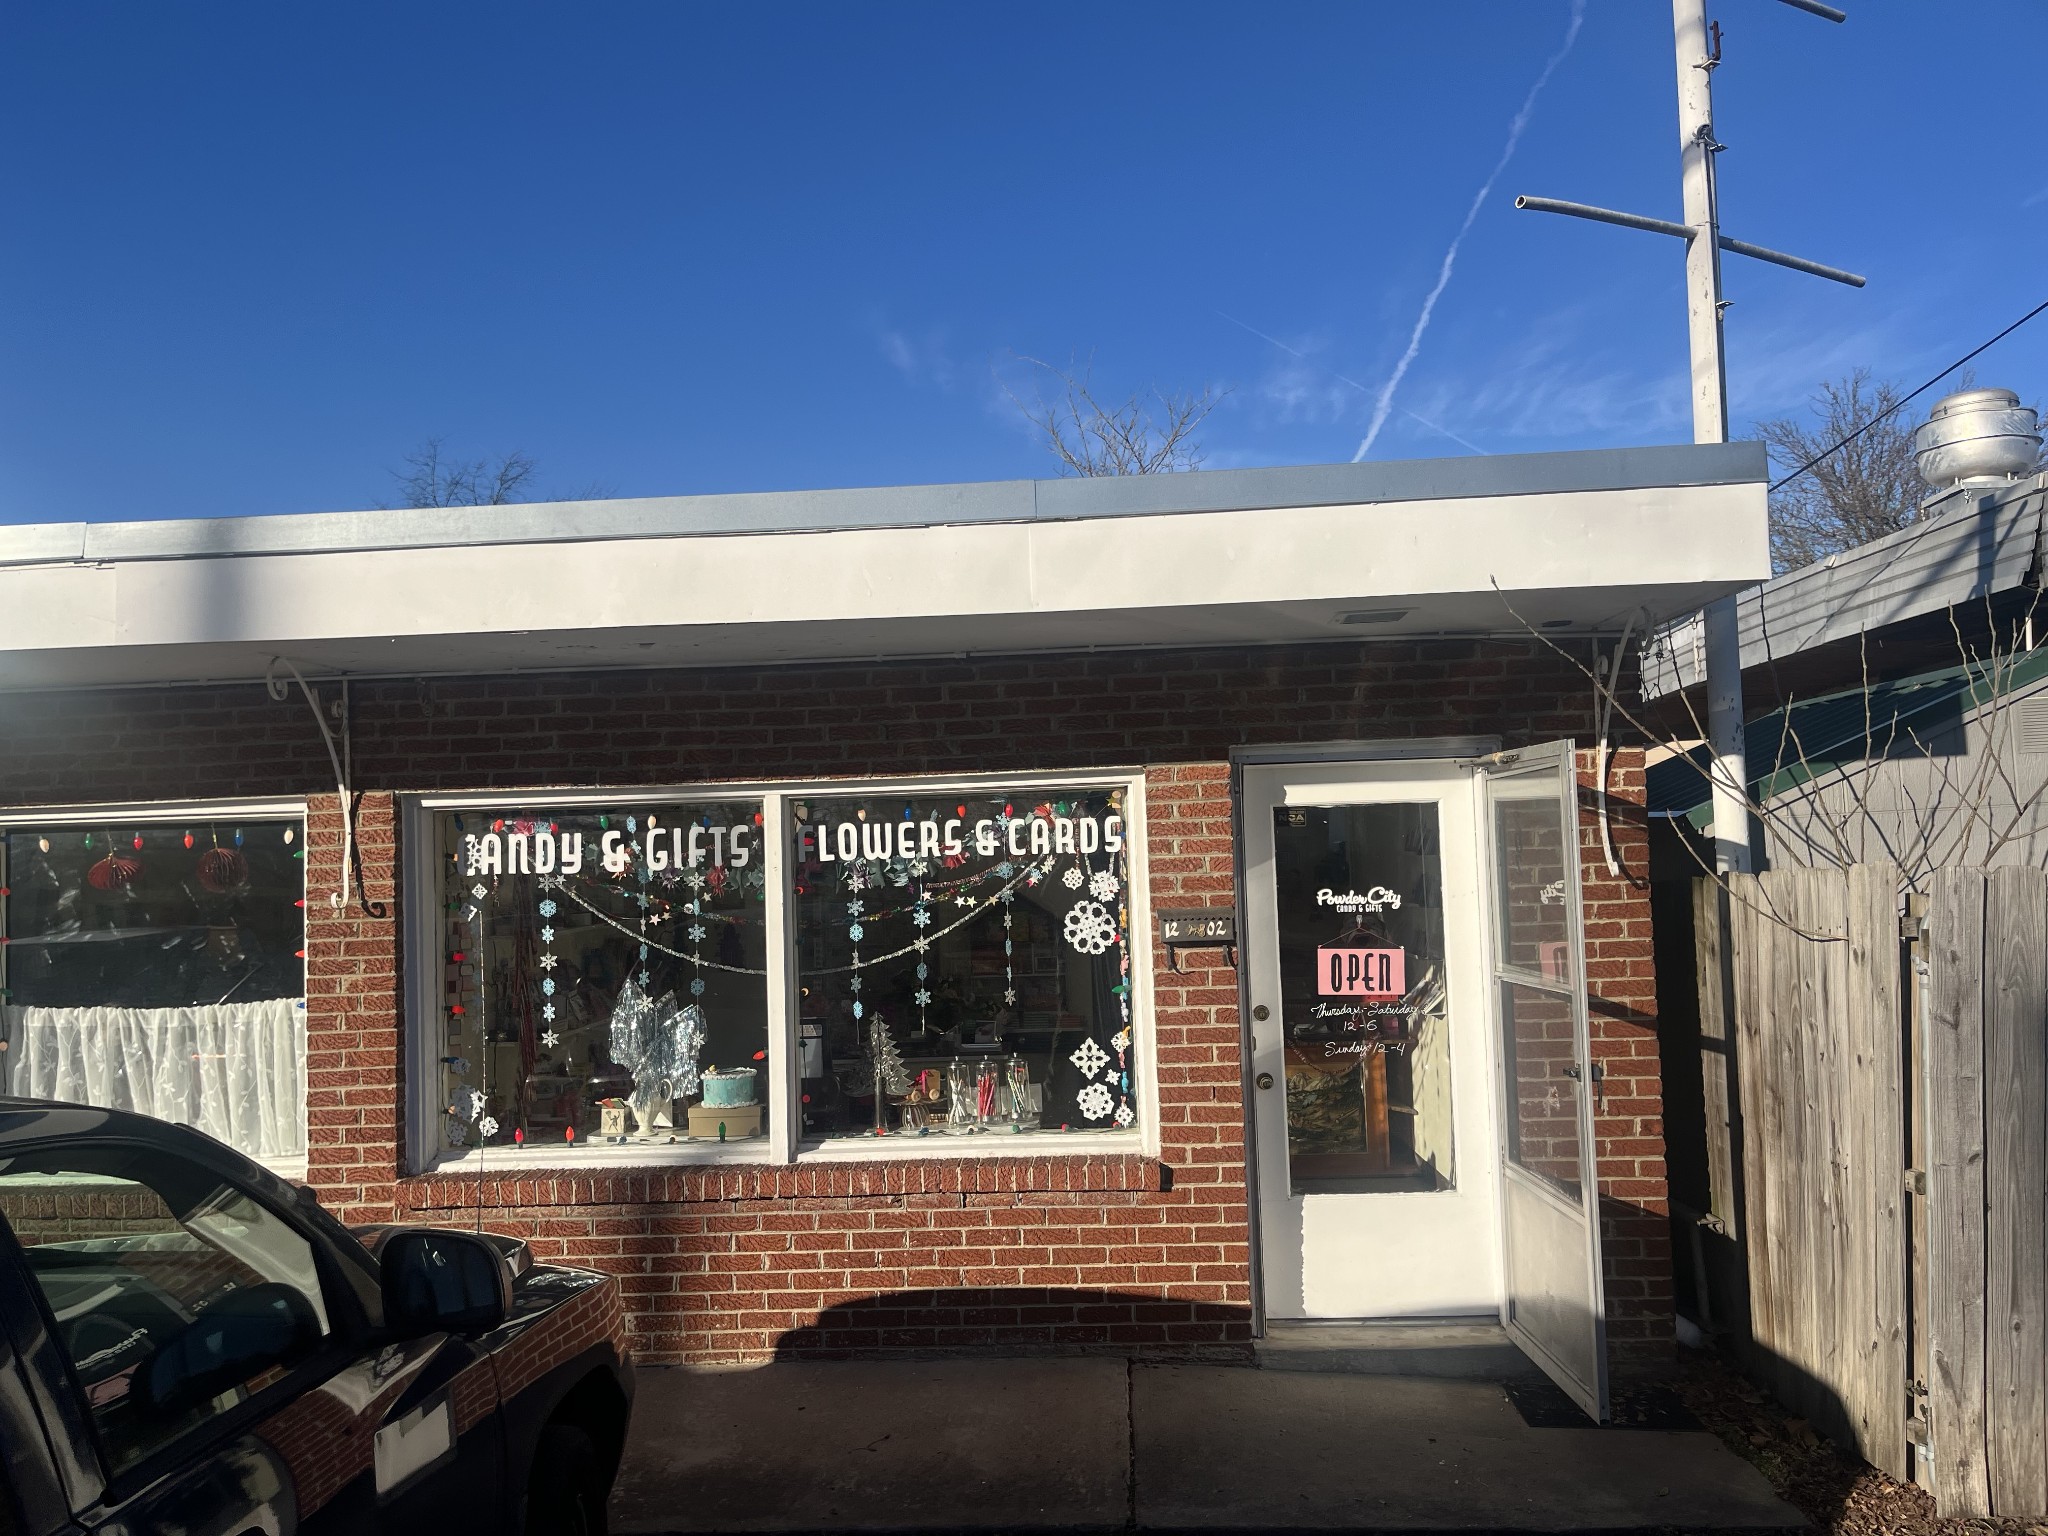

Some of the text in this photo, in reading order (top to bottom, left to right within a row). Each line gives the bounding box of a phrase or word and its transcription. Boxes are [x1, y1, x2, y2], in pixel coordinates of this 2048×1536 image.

[601, 830, 629, 874] &
[646, 824, 750, 872] GIFTS
[798, 815, 1122, 863] FLOWERS & CARDS
[1316, 886, 1402, 910] Powder City
[1336, 904, 1357, 913] CANDY
[1365, 904, 1383, 913] GIFTS
[1164, 920, 1227, 939] 12 02
[1330, 953, 1392, 993] OPEN
